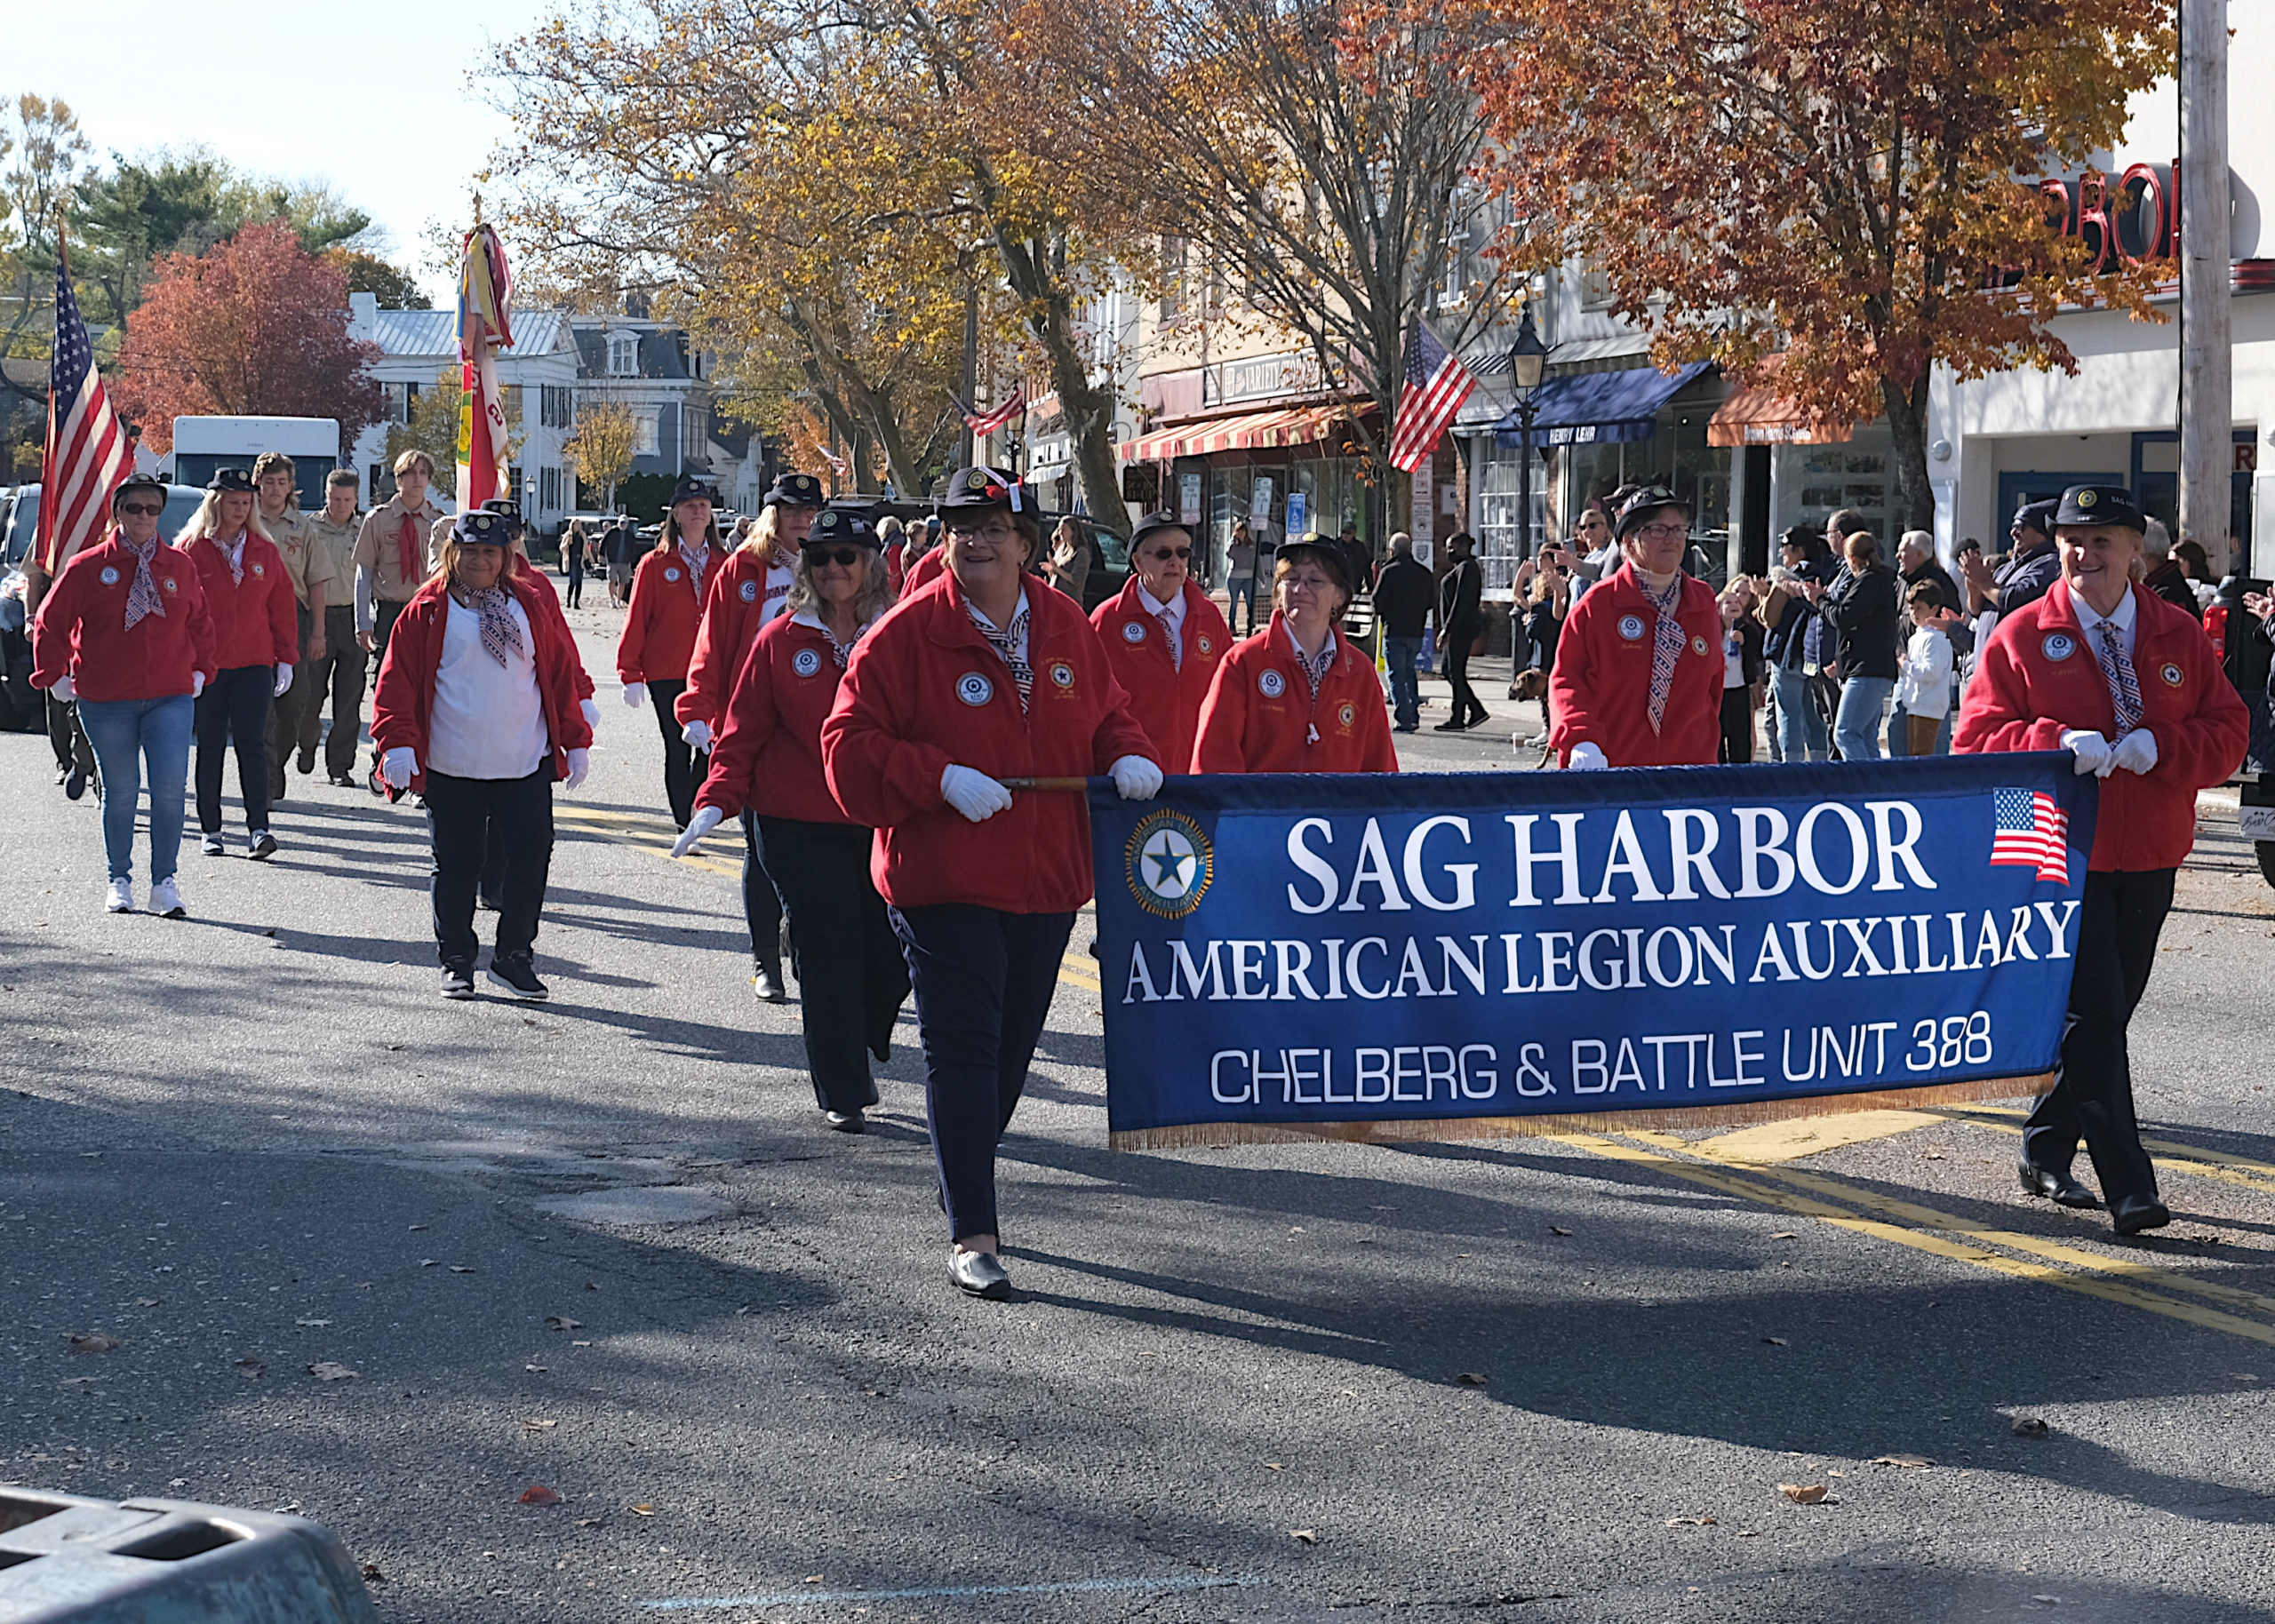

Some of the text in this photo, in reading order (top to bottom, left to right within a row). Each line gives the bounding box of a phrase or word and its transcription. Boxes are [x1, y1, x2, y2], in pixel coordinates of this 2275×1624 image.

[1245, 362, 1281, 392] VARIETY
[1549, 426, 1596, 444] HENRY LEHR
[1744, 424, 1765, 441] Brown
[1765, 424, 1784, 441] Harris
[1131, 818, 1206, 865] AMERICAN LEGION
[1287, 801, 1937, 915] SAG HARBOR
[1138, 887, 1194, 910] AUXILIARY
[1122, 900, 2080, 1005] AMERICAN LEGION AUXILIARY
[1209, 1010, 1992, 1103] CHELBERG & BATTLE UNIT 388
